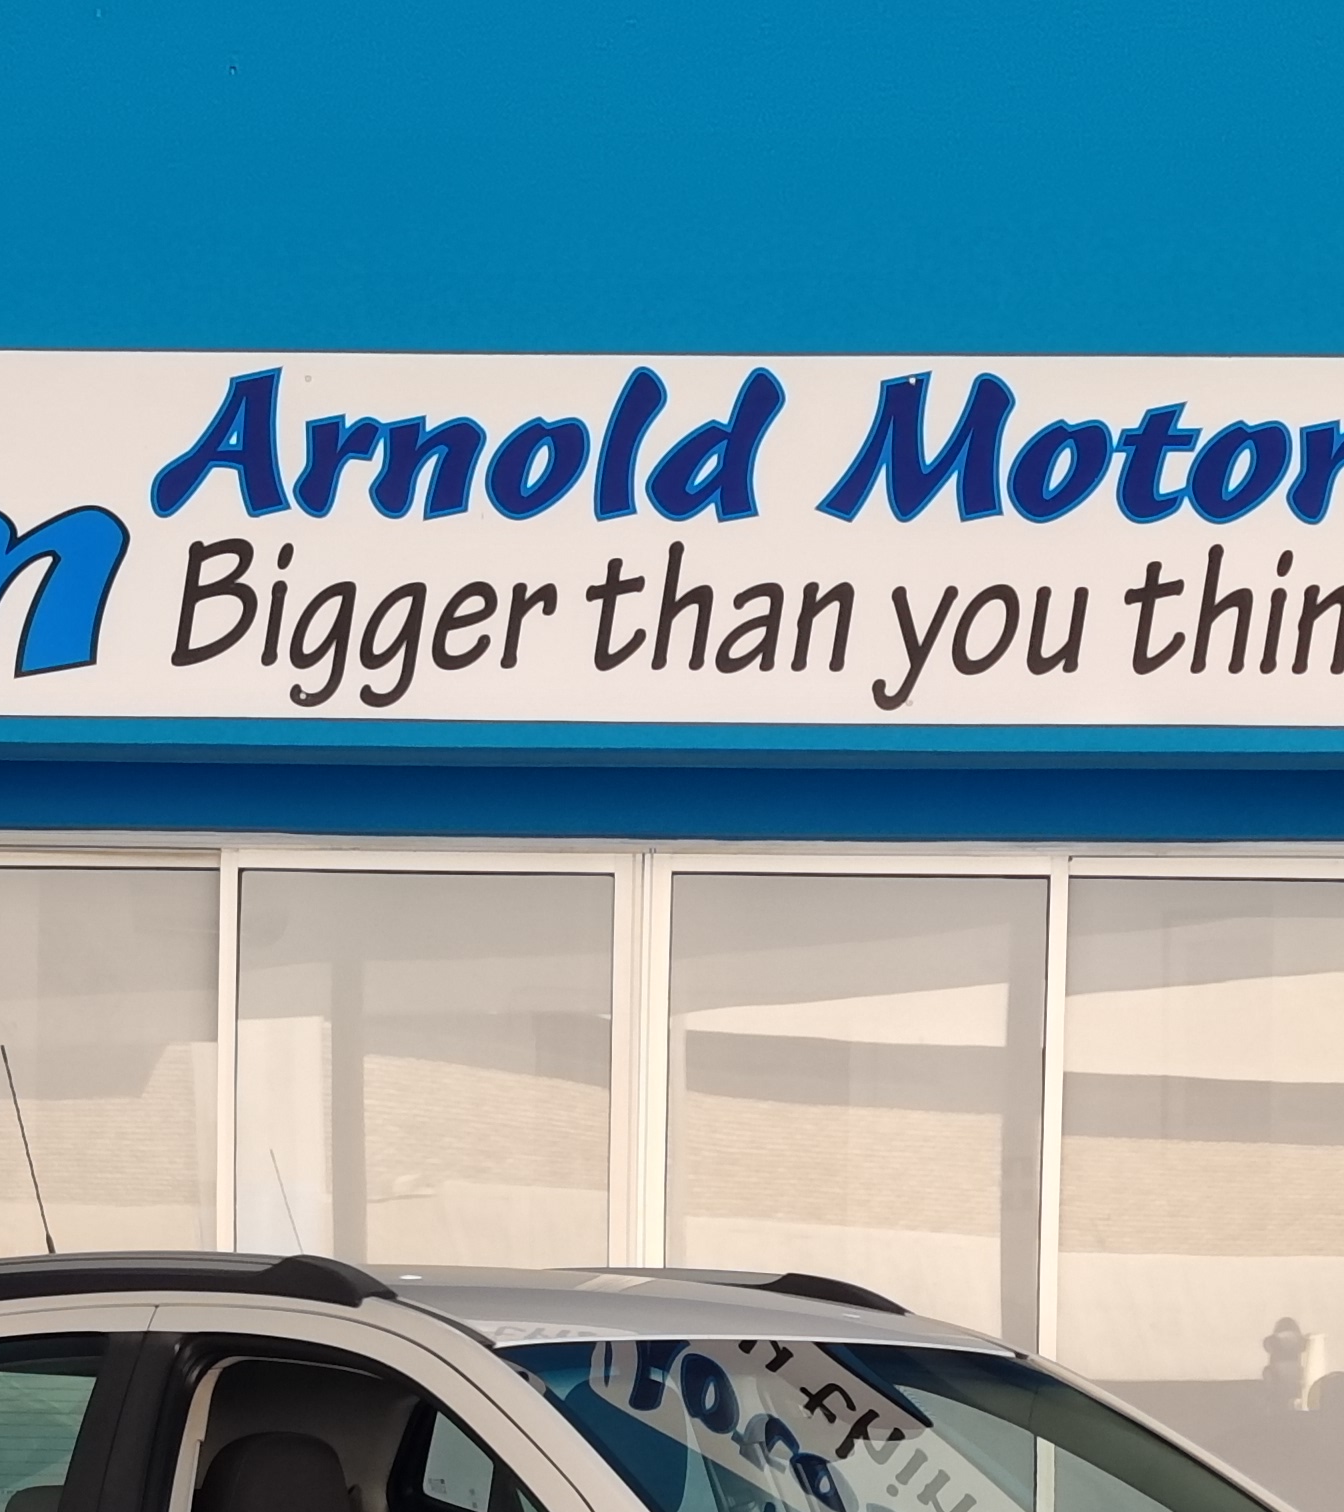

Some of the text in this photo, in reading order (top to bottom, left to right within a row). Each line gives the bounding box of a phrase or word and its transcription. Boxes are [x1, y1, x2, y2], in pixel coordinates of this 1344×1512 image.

[150, 366, 786, 524] Arnold
[170, 538, 557, 708] Bigger
[586, 540, 855, 675] than
[872, 585, 1089, 712] you
